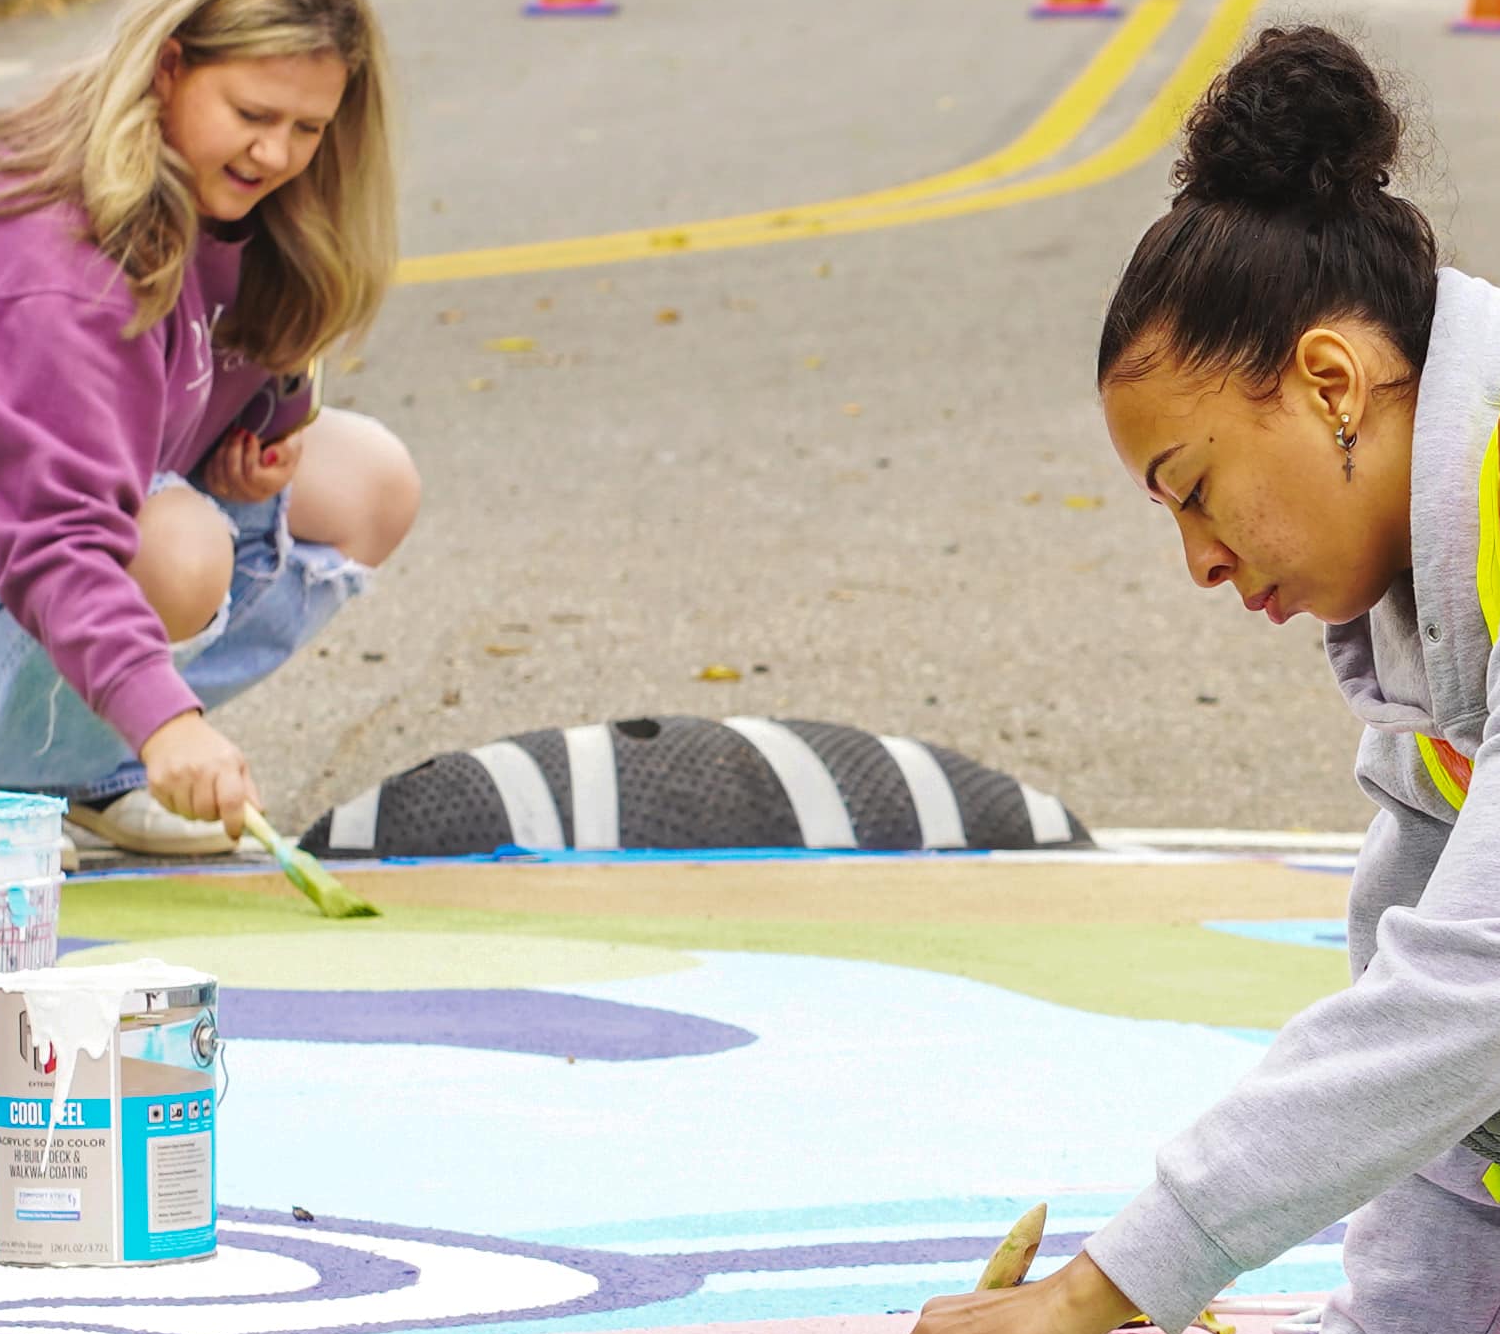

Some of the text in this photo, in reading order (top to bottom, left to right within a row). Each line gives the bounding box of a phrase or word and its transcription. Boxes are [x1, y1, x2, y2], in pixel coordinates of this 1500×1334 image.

[9, 1101, 86, 1126] COOL EEL
[33, 1138, 65, 1148] SOID
[67, 1138, 107, 1148] COLOR
[48, 1149, 69, 1164] DECK
[73, 1149, 81, 1164] &
[9, 1165, 88, 1180] WALKWAY COATING
